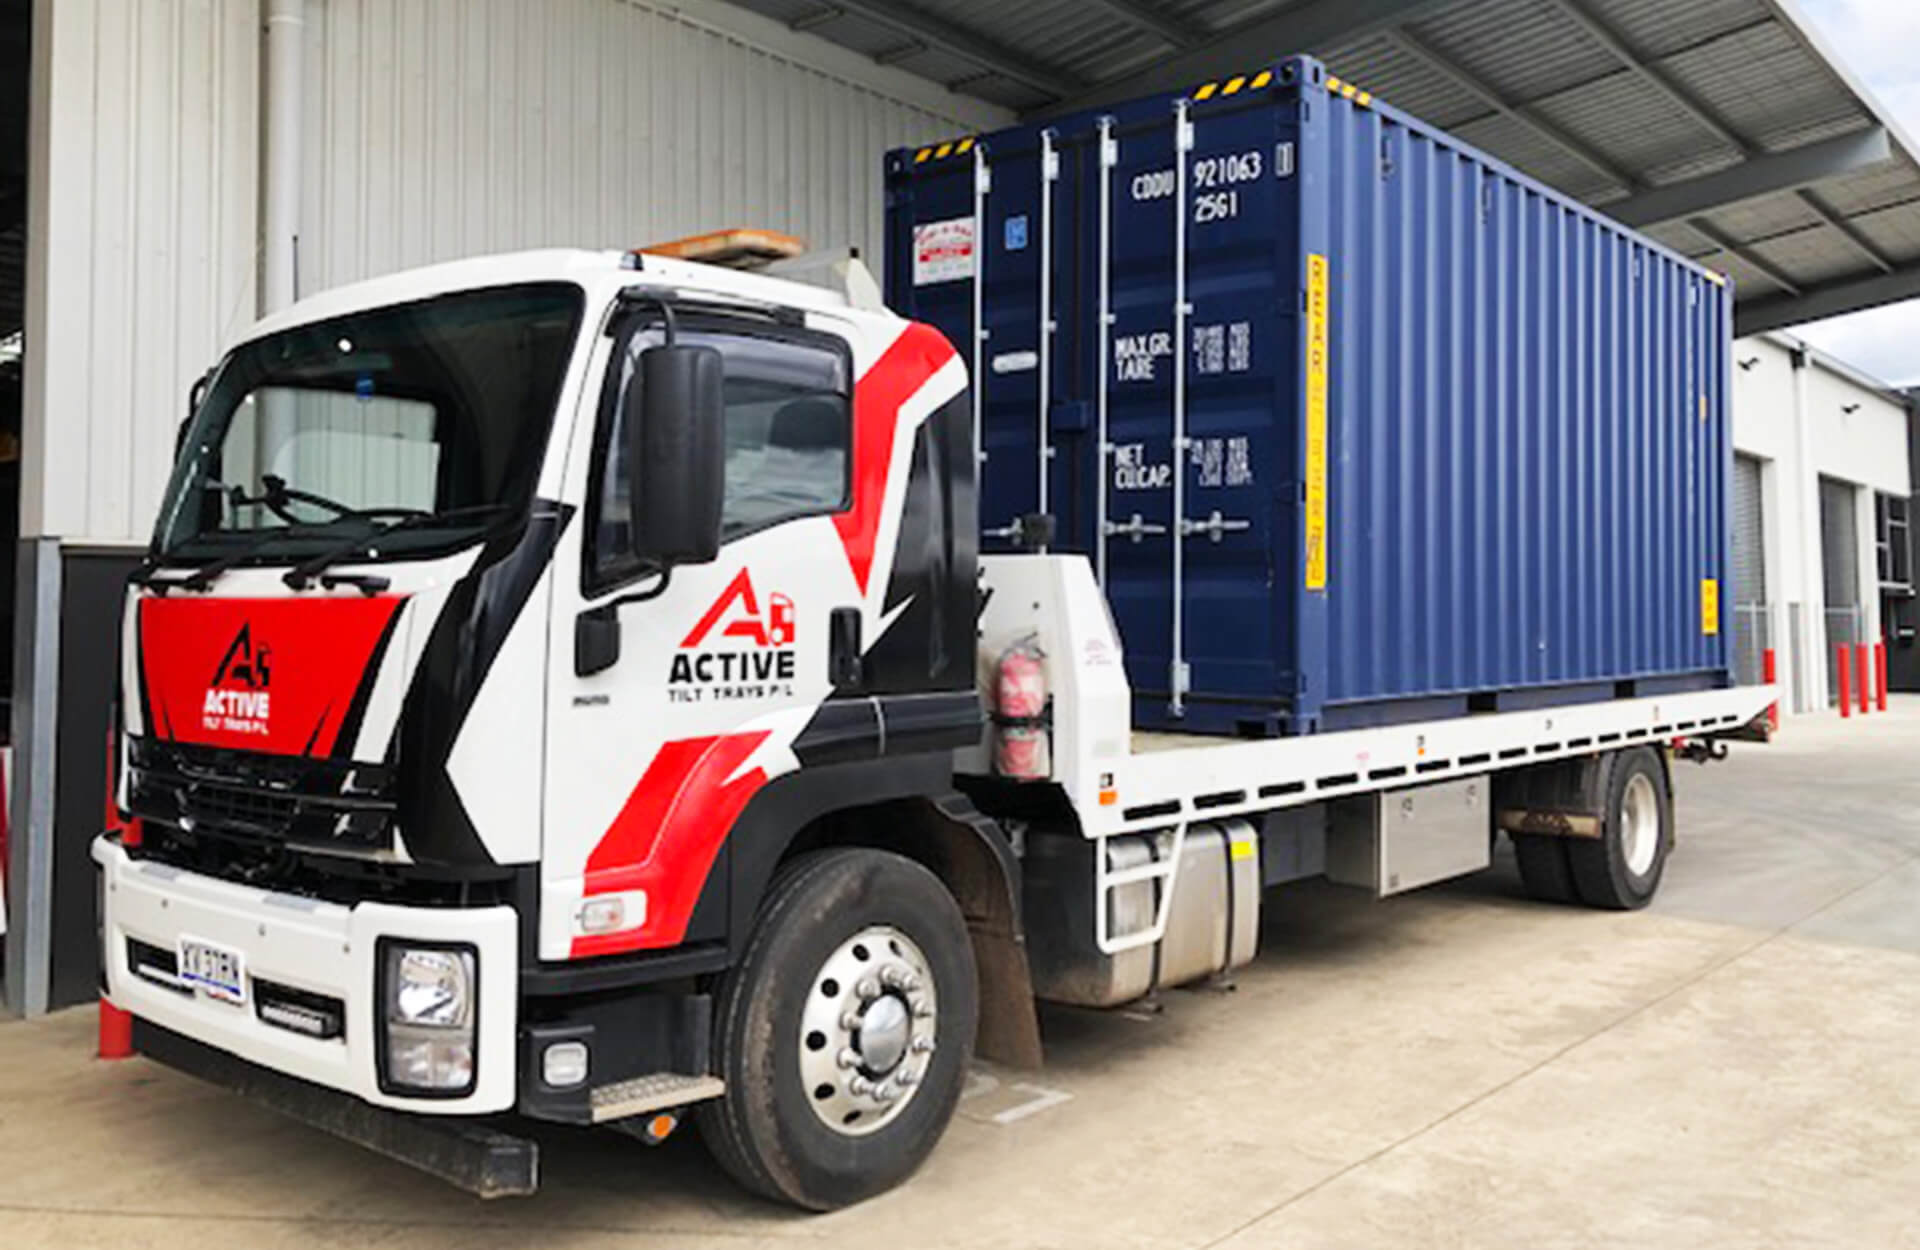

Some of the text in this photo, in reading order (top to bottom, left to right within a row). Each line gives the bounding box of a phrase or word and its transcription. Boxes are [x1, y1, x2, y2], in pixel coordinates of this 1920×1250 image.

[1132, 170, 1175, 200] CDDU
[1194, 152, 1262, 188] 921063
[1194, 192, 1237, 223] 25G1
[1116, 356, 1154, 381] TARE
[1115, 444, 1144, 467] NET
[668, 650, 795, 684] ACTIVE
[203, 688, 270, 718] ACTIVE
[668, 687, 703, 702] TILT
[714, 684, 764, 700] TRAYS
